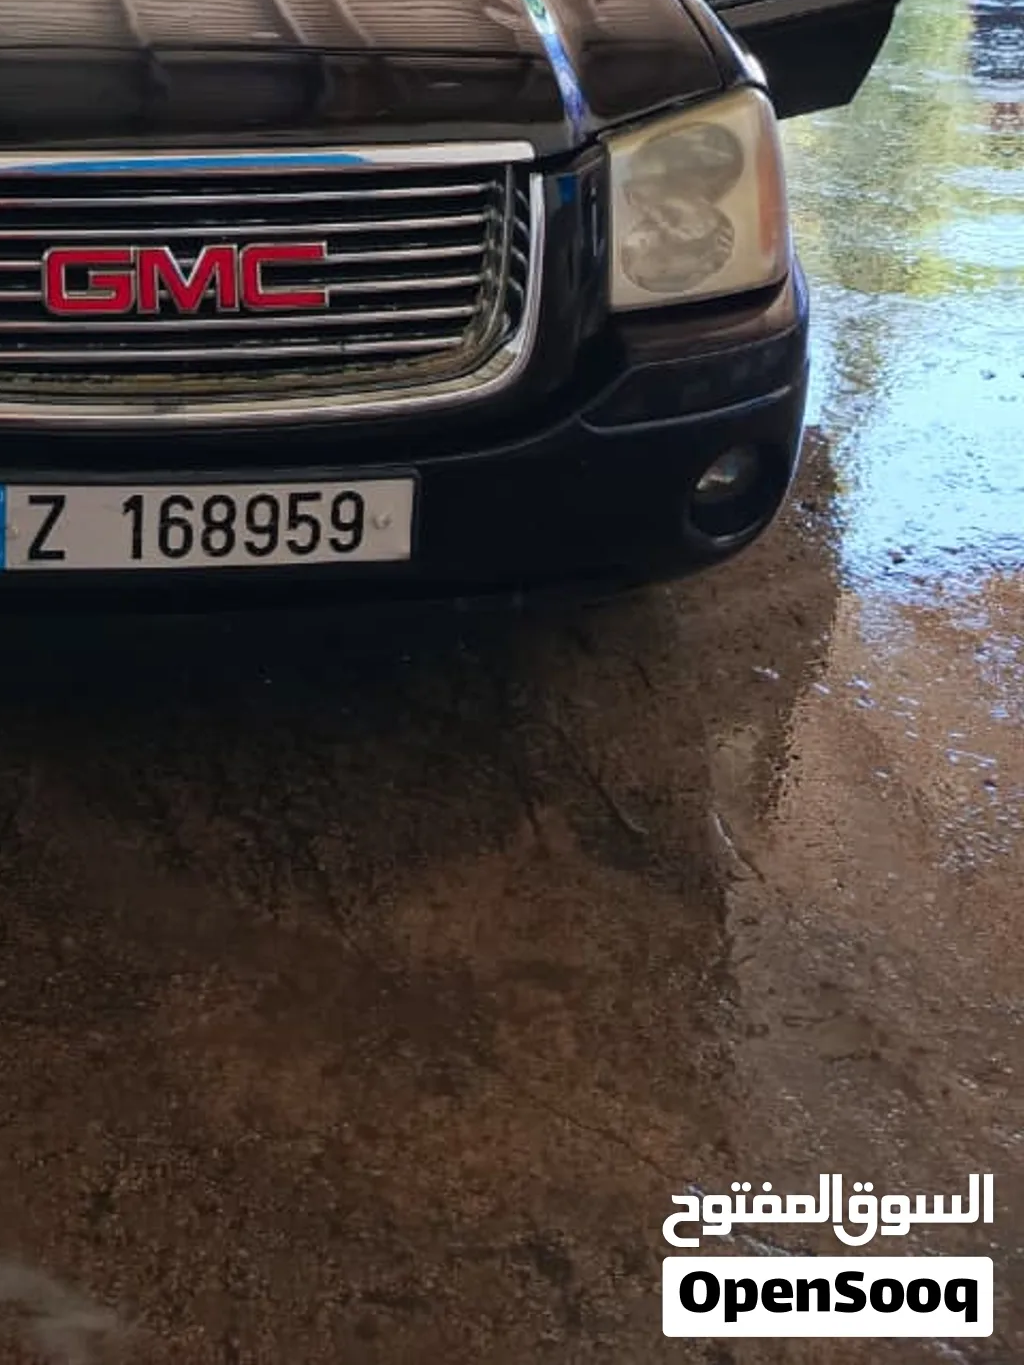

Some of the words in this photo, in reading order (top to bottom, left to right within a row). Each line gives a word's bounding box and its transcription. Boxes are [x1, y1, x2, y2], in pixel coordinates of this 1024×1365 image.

[43, 241, 329, 315] GMC
[26, 494, 67, 560] Z
[122, 491, 366, 559] 168959
